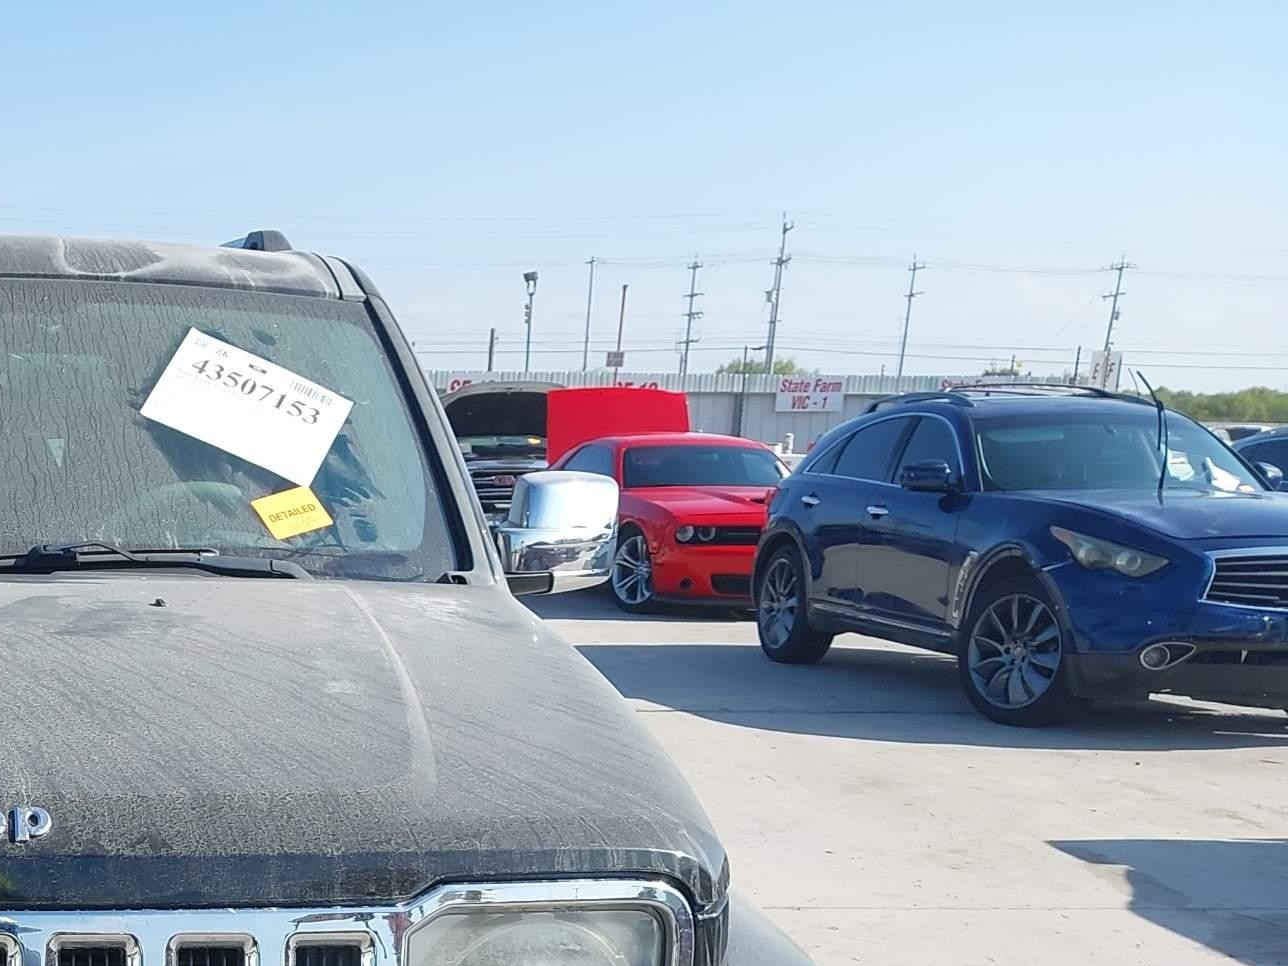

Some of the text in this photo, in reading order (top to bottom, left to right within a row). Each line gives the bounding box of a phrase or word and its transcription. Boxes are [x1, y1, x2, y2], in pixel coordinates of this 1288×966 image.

[191, 359, 321, 425] 43507153
[780, 379, 842, 393] State Farm
[268, 503, 316, 523] DETAILED
